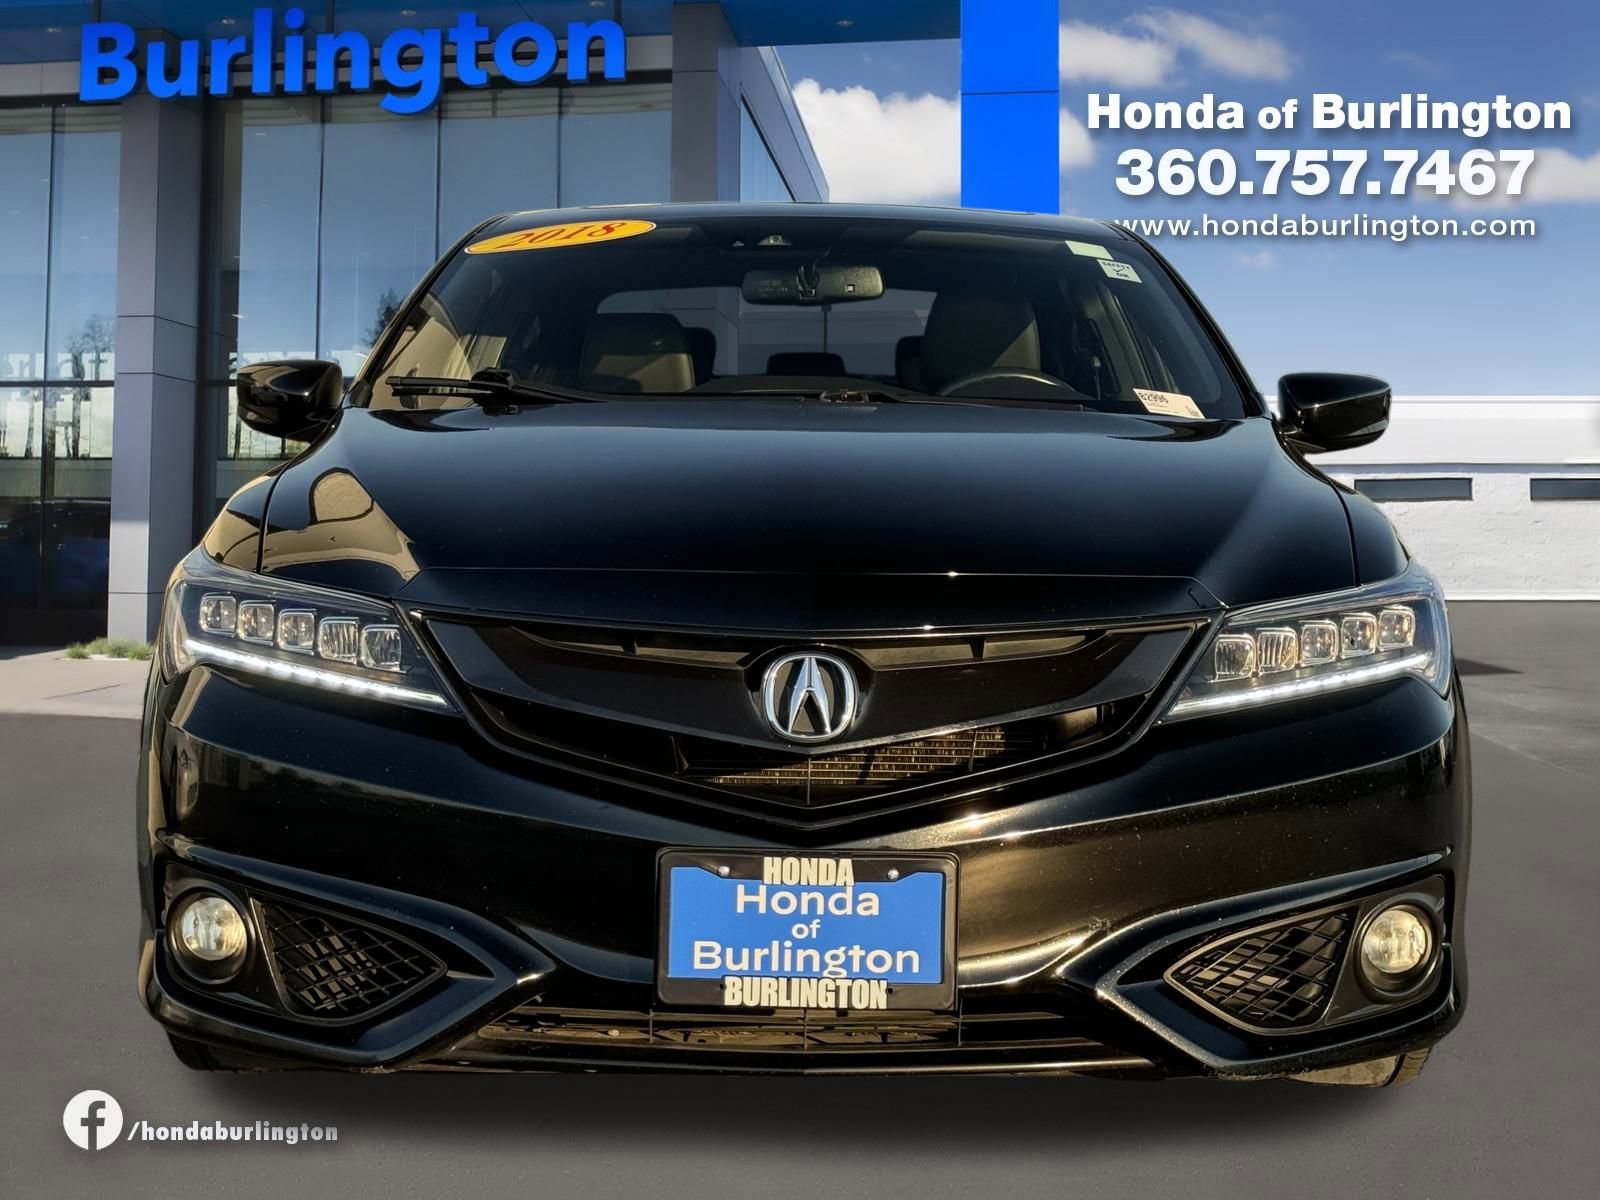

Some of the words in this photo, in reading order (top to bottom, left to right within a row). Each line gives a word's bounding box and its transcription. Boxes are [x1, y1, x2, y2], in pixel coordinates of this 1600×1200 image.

[80, 8, 626, 114] Burlington
[493, 222, 626, 249] 2018
[763, 856, 855, 887] HONDA
[736, 884, 880, 916] Honda
[791, 919, 821, 939] of
[693, 940, 920, 978] Burlington
[723, 976, 888, 1010] BURLINGTON
